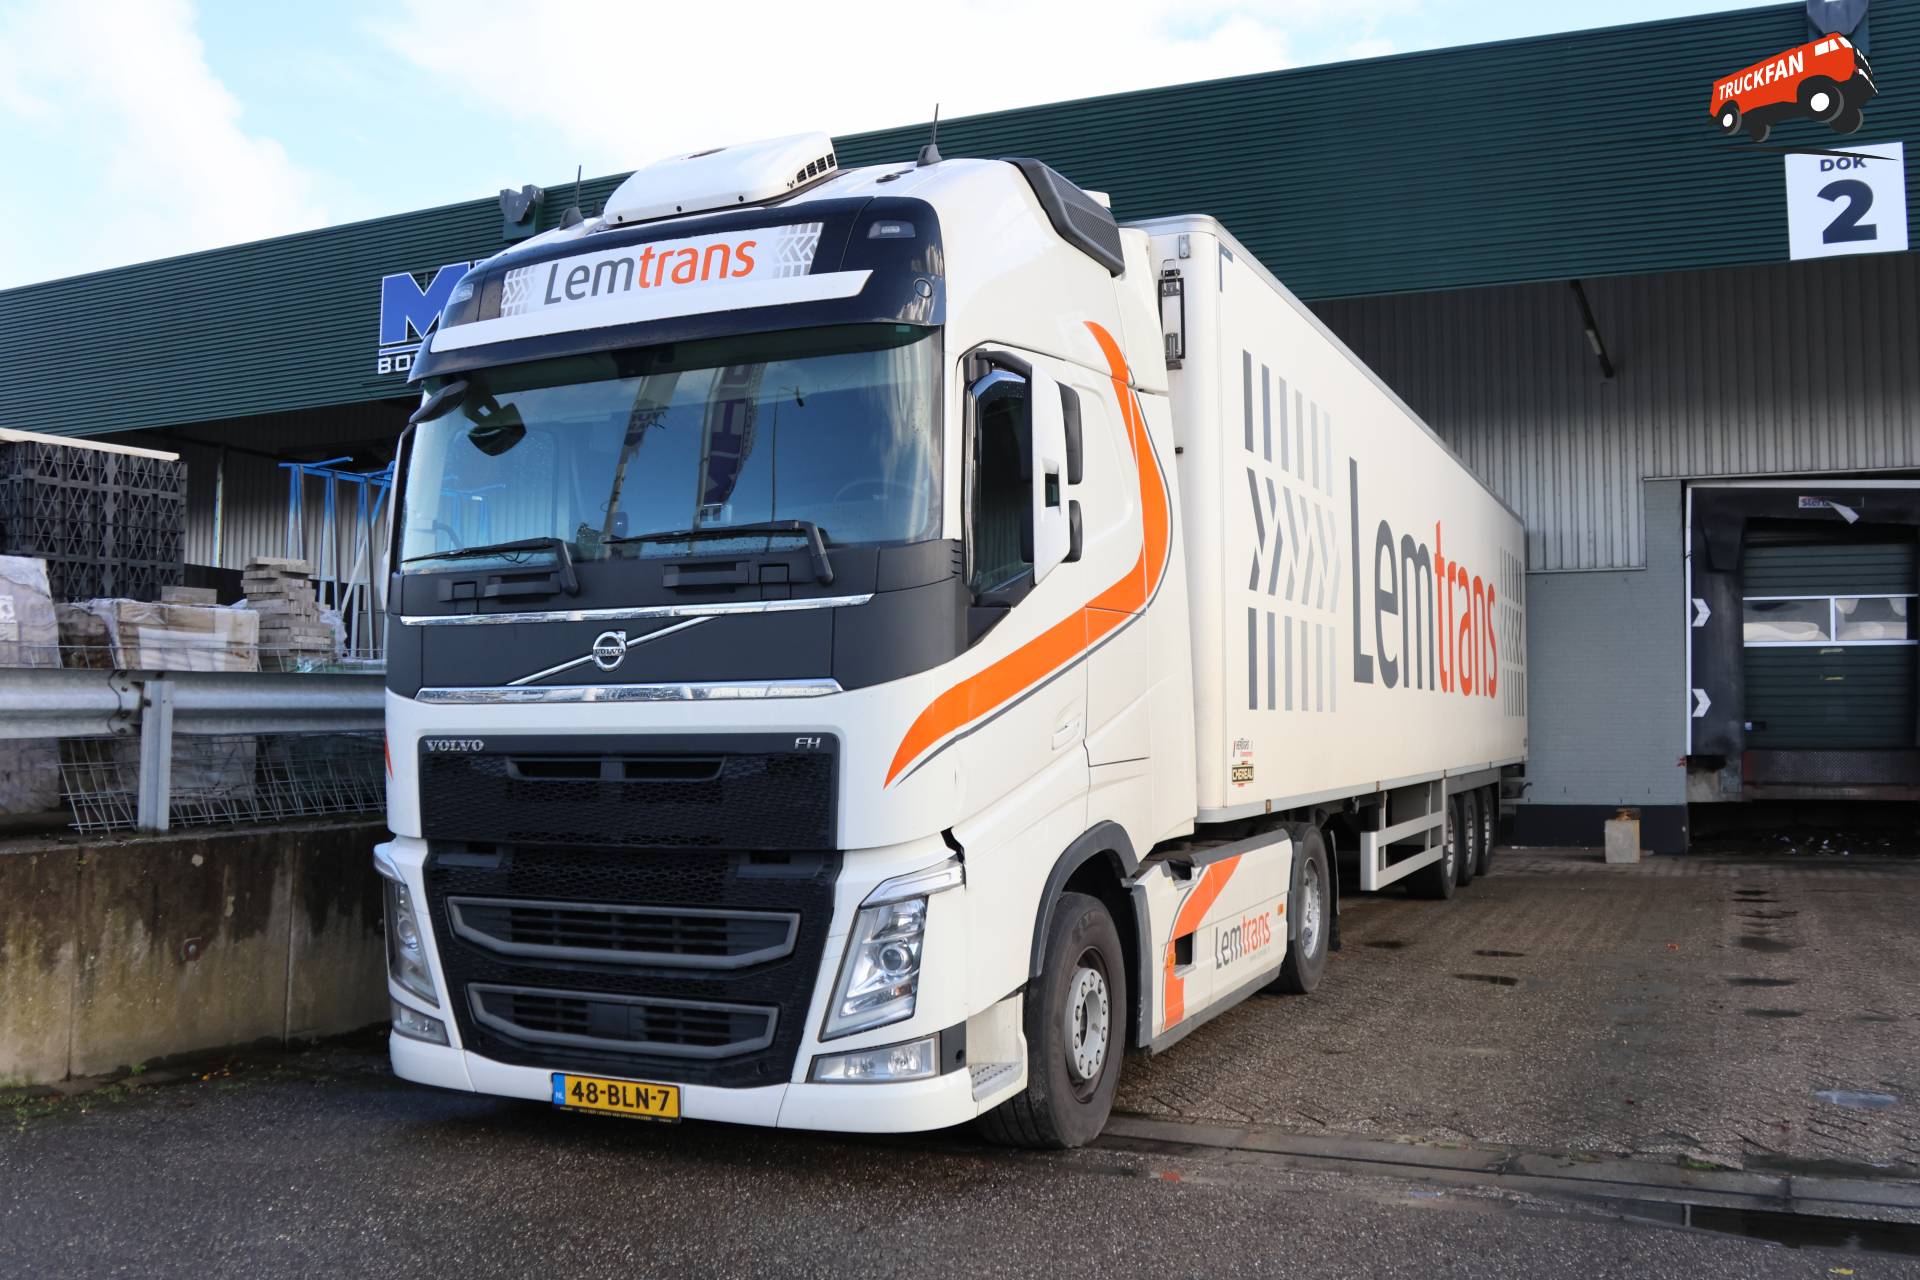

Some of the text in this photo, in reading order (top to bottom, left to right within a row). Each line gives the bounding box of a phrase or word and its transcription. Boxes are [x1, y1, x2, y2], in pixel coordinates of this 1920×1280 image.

[1820, 156, 1867, 172] DOK
[1817, 179, 1877, 244] 2
[543, 240, 757, 304] Lemtrans
[380, 259, 488, 346] M
[378, 354, 412, 374] BO
[1350, 456, 1497, 698] Lemtrans
[595, 648, 624, 656] VOLVO
[425, 739, 484, 751] VOLVO
[795, 737, 821, 749] FH
[1215, 911, 1271, 969] Lemtrans
[571, 1081, 670, 1111] 48-BLN-7
